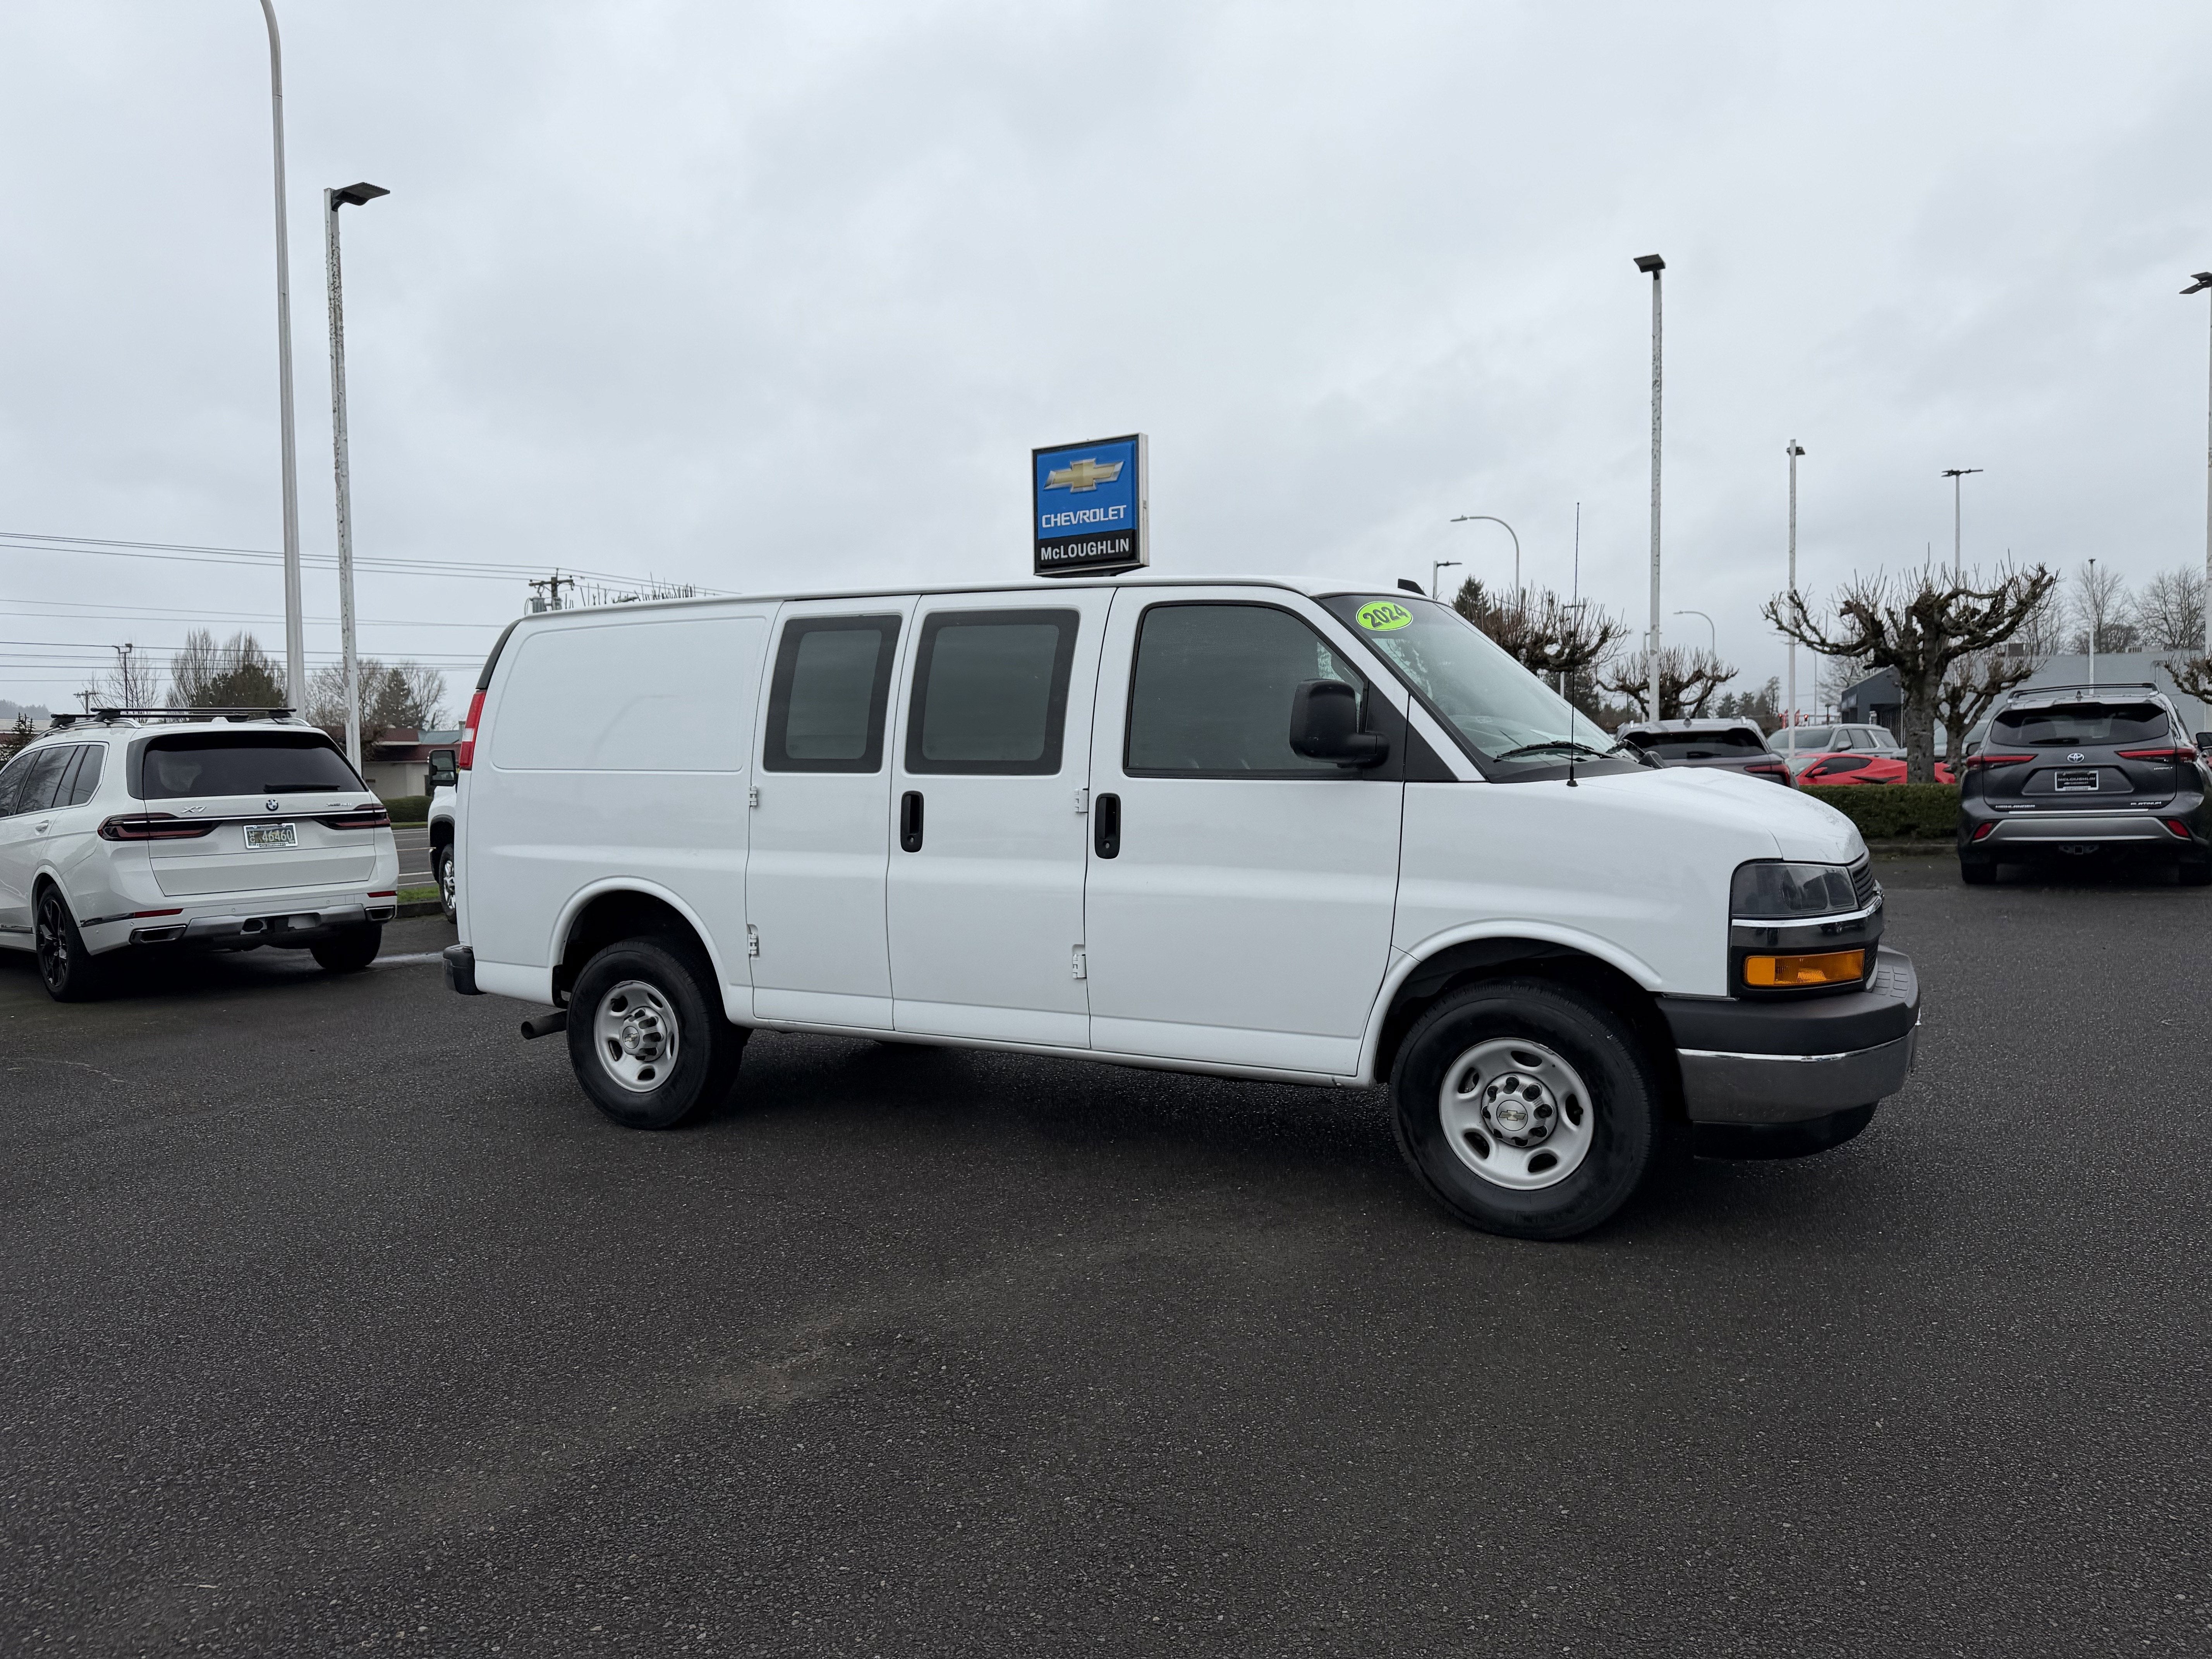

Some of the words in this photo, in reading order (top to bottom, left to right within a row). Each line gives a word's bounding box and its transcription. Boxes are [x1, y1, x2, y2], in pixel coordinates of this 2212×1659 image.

[1042, 505, 1127, 528] CHEVROLET
[1041, 538, 1129, 560] McLOUGHLIN
[1363, 605, 1409, 628] 2024
[262, 829, 293, 842] 46460
